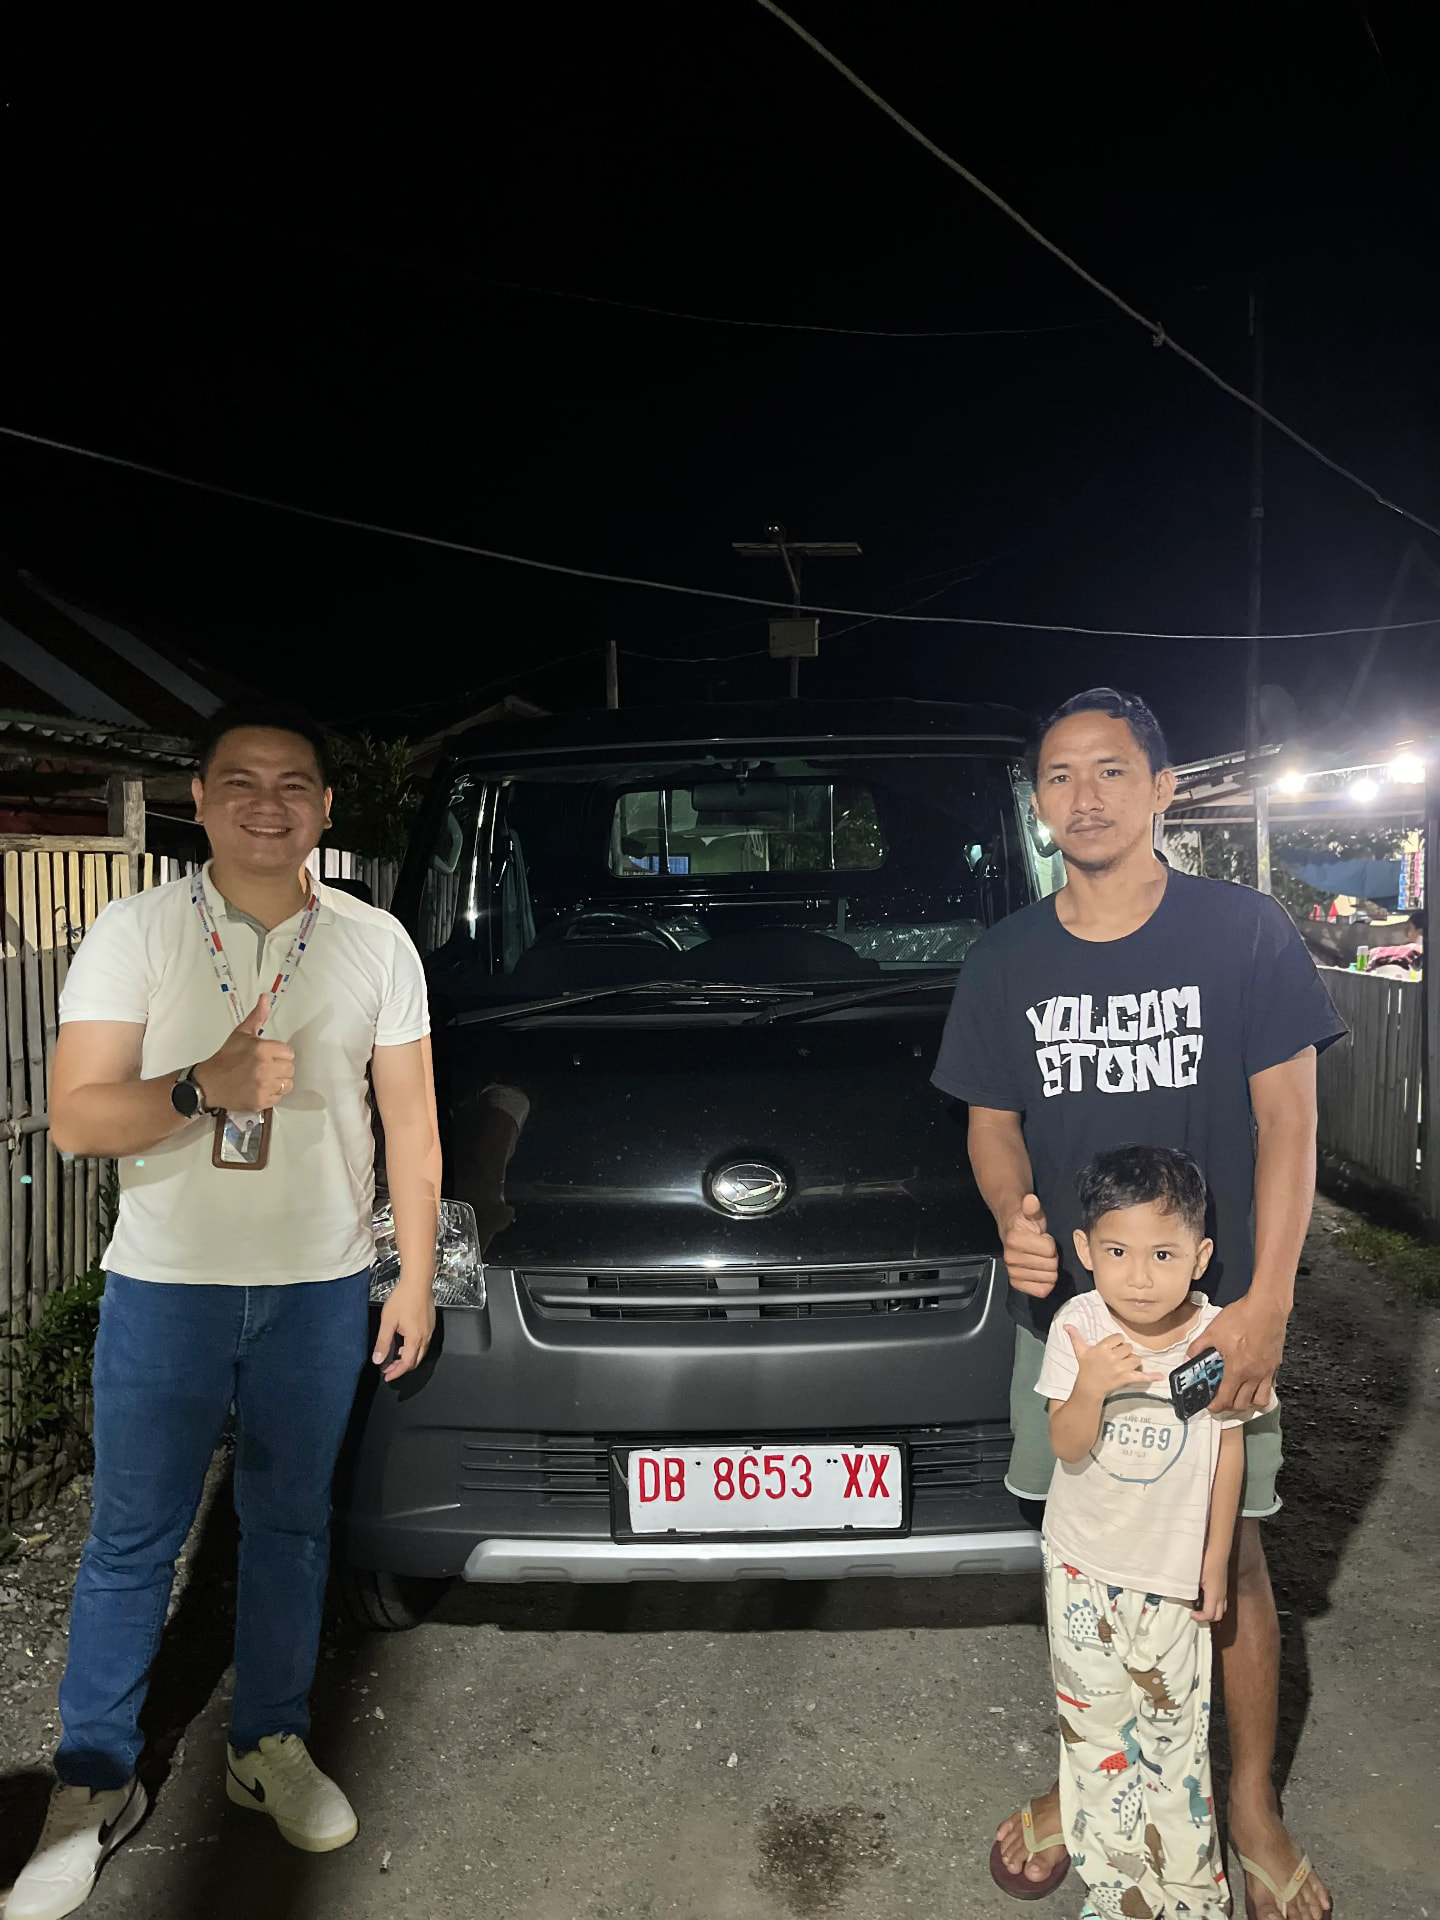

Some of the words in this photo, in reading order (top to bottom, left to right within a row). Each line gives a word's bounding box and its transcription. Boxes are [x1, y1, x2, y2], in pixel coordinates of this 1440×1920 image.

[1026, 986, 1201, 1041] VOLCOM
[1036, 1035, 1203, 1097] STONE
[639, 1457, 685, 1502] DB
[713, 1455, 812, 1500] 8653
[841, 1454, 890, 1498] XX
